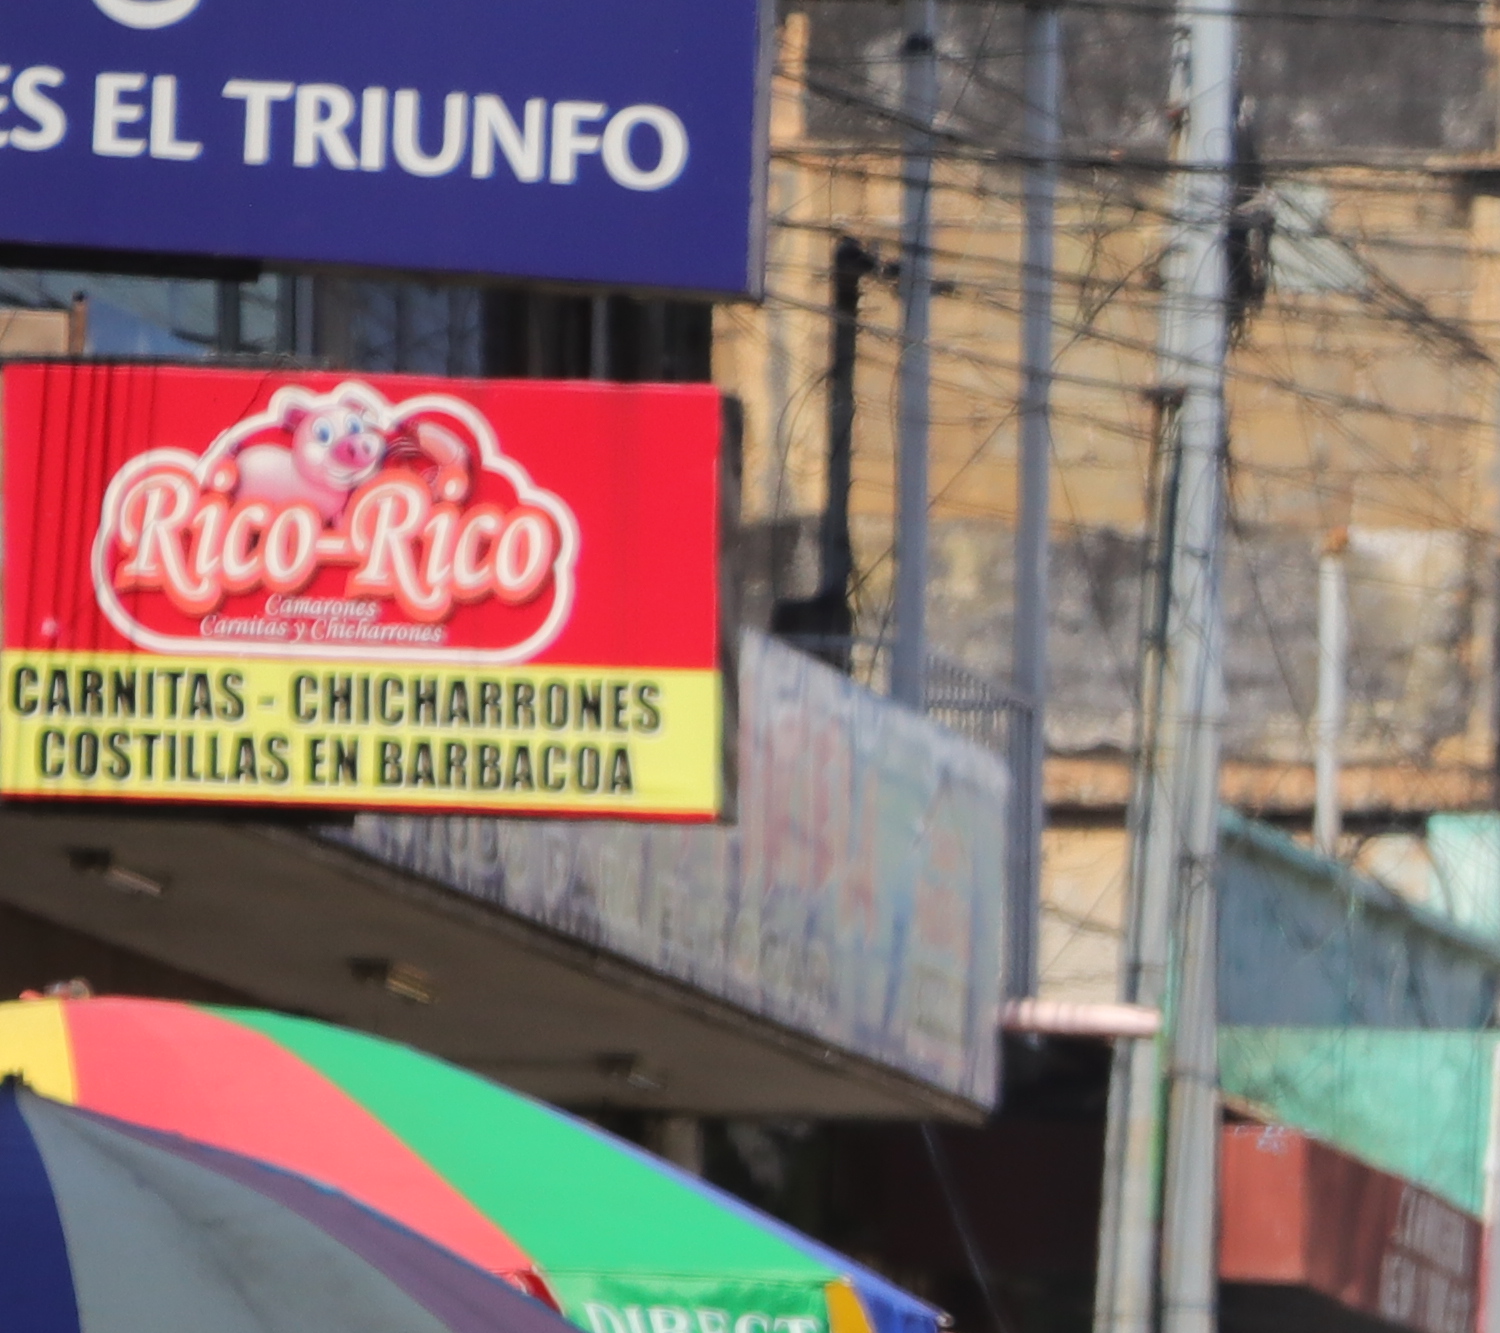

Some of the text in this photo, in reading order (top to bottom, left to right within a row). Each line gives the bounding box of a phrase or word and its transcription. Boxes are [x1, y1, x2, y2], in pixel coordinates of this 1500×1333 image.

[92, 74, 202, 159] EL
[224, 80, 688, 190] TRIUNFO
[113, 472, 549, 600] Rico-Rico
[200, 615, 288, 637] Carnitas
[310, 618, 443, 643] Chicharrones
[264, 594, 379, 621] Camarones
[12, 668, 246, 722] CARNITAS
[291, 672, 664, 734] CHICHARRONES
[38, 729, 637, 796] COSTILLAS EN BARBACOA
